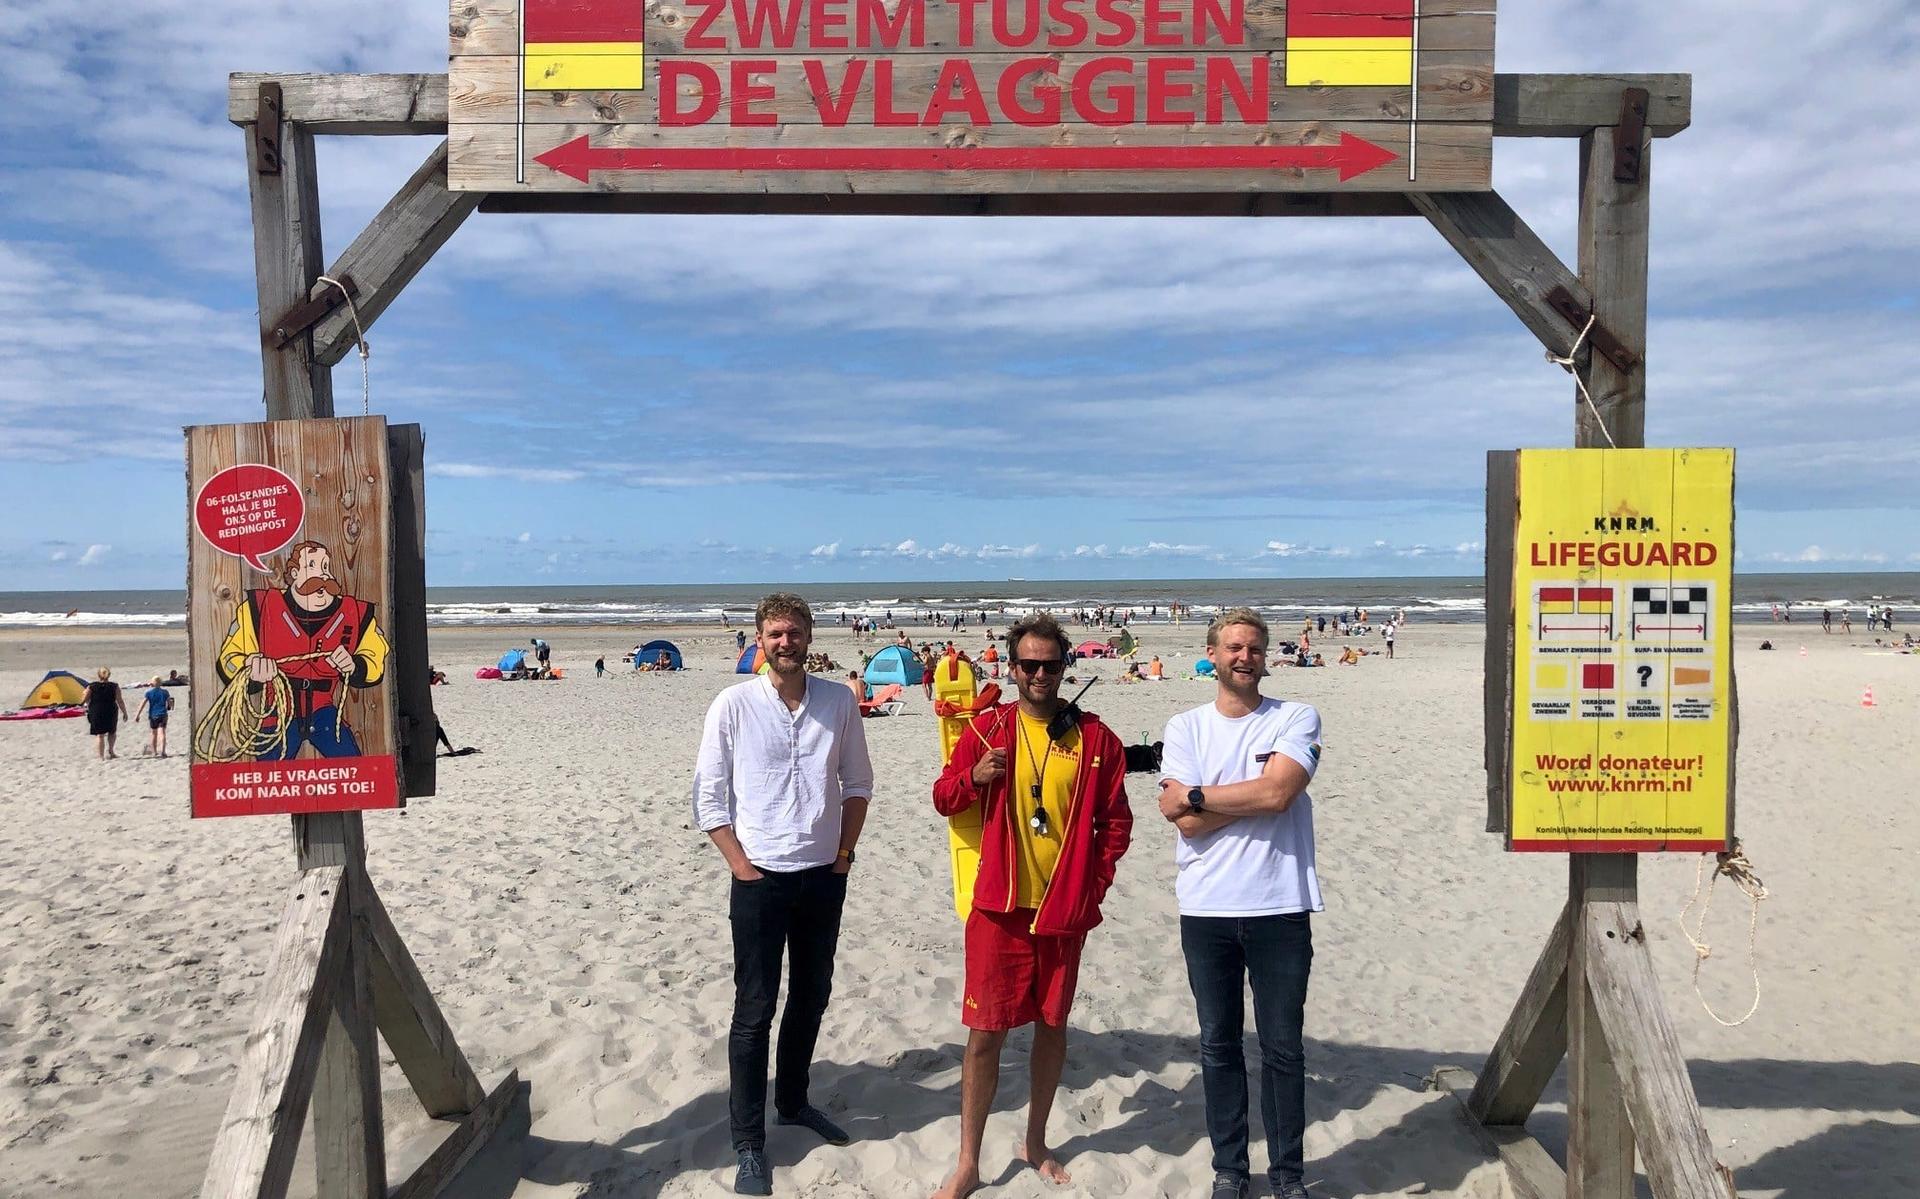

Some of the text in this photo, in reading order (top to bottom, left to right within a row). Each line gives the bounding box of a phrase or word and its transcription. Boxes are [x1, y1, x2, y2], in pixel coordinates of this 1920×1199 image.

[683, 0, 1245, 49] ZWEM TUSSEN
[658, 57, 1270, 128] DE VLAGGEN
[222, 498, 277, 516] HAAL JE BIJ
[225, 509, 277, 526] ONS OP DE
[1594, 517, 1654, 531] KNRM
[218, 519, 286, 538] REDDINGPOST
[1531, 542, 1718, 567] LIFEGUARD
[1536, 754, 1703, 770] Word donateur!
[233, 767, 358, 785] HEB JE VRAGEN?
[1548, 776, 1692, 792] www.knrm.nl
[215, 781, 375, 801] KOM NAAR ONS TOE!
[1536, 826, 1703, 836] Koninklijke Nederlandse Redding Maatschappij
